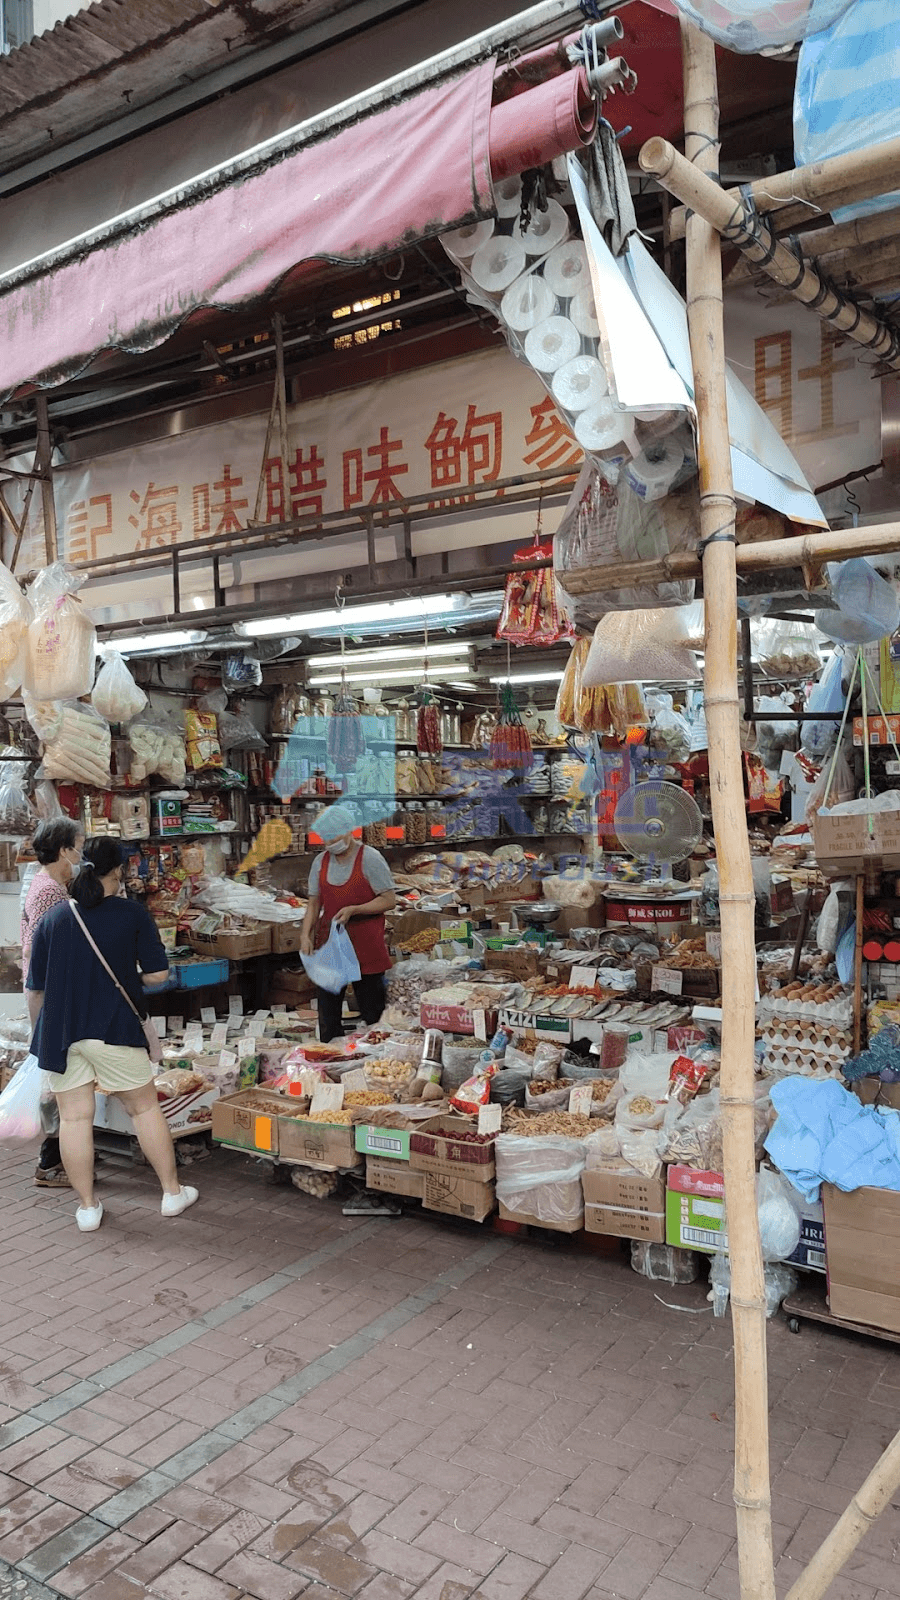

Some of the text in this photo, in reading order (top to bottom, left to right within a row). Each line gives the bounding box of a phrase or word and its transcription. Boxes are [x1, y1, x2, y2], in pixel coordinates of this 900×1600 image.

[647, 908, 675, 918] SKOL
[456, 1009, 474, 1021] vit
[497, 1008, 537, 1028] AZIZI
[167, 1119, 186, 1131] ONDS
